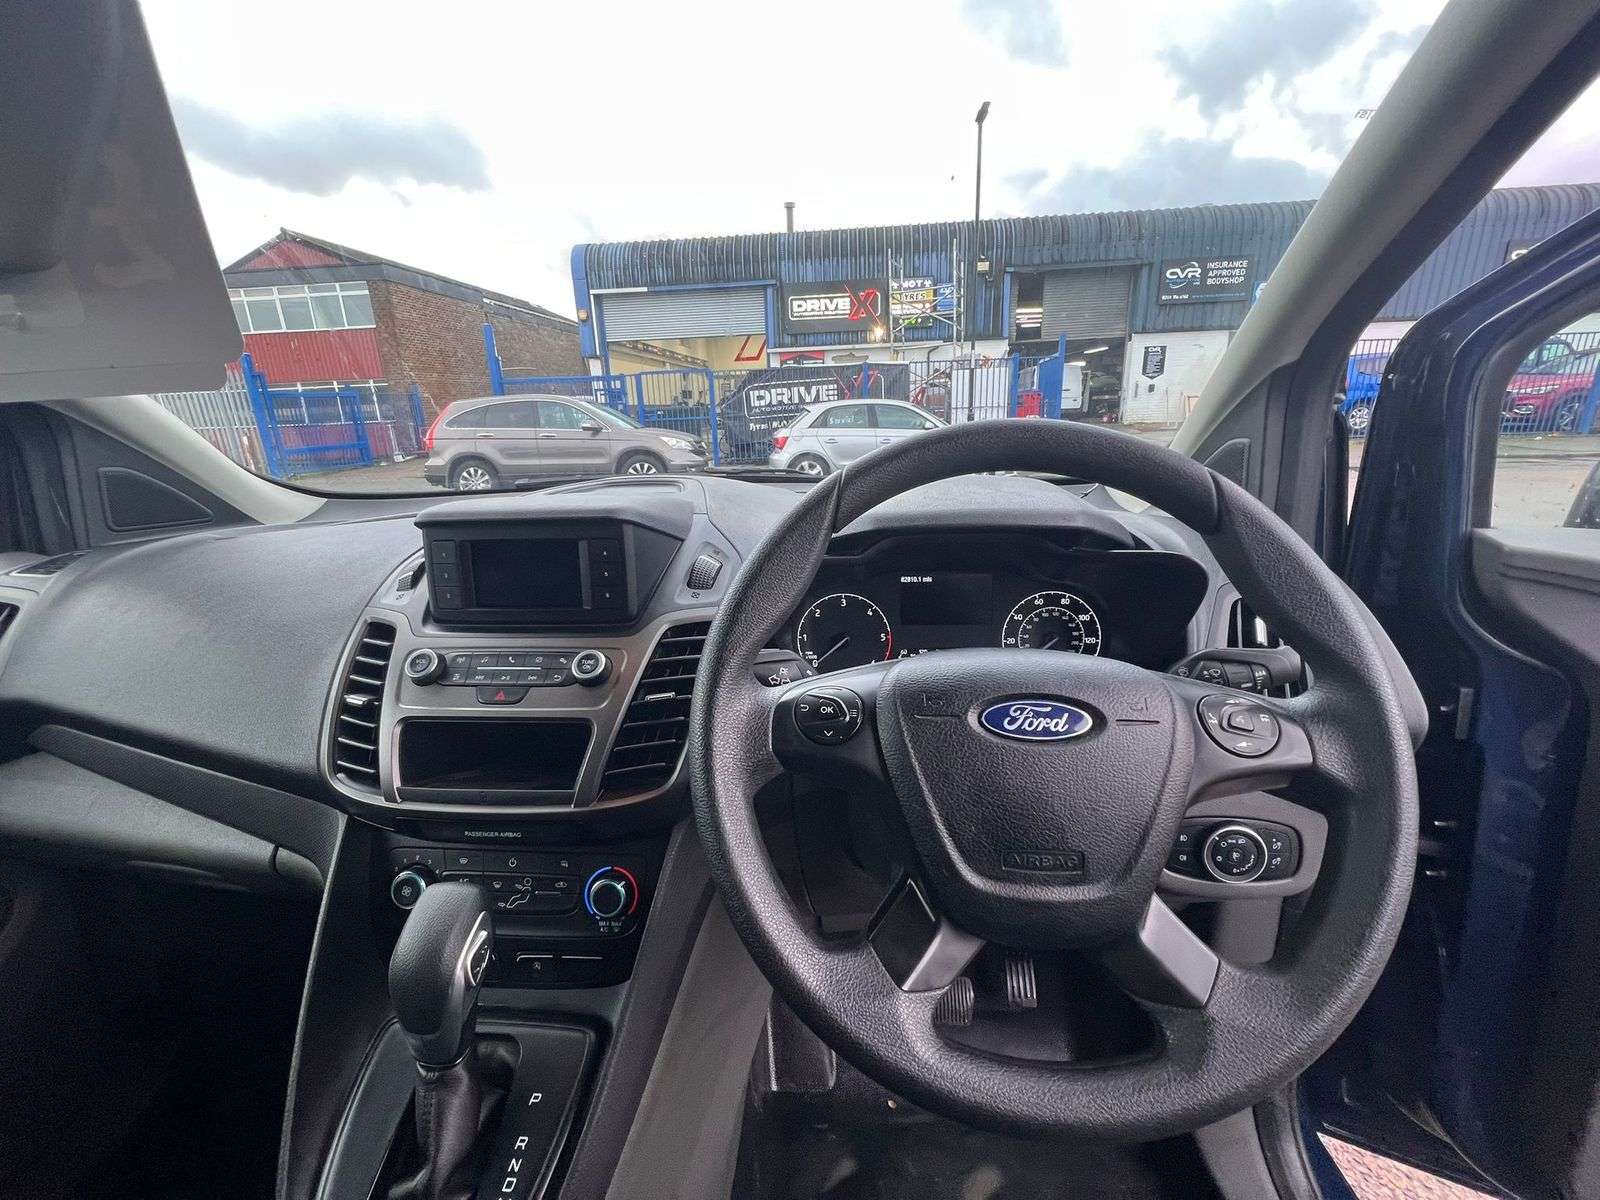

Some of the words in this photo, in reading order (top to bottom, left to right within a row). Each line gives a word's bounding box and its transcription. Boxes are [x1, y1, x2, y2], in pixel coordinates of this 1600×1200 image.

[1206, 260, 1248, 269] INSURANCE
[1166, 268, 1202, 279] CVR
[1208, 268, 1246, 277] APPROVED
[1206, 276, 1245, 285] BODYSHOP
[1003, 704, 1068, 732] Ford
[1010, 854, 1078, 868] AIRBAG
[528, 1093, 542, 1106] P
[514, 1136, 528, 1150] R
[508, 1158, 522, 1172] N
[502, 1177, 516, 1192] D
